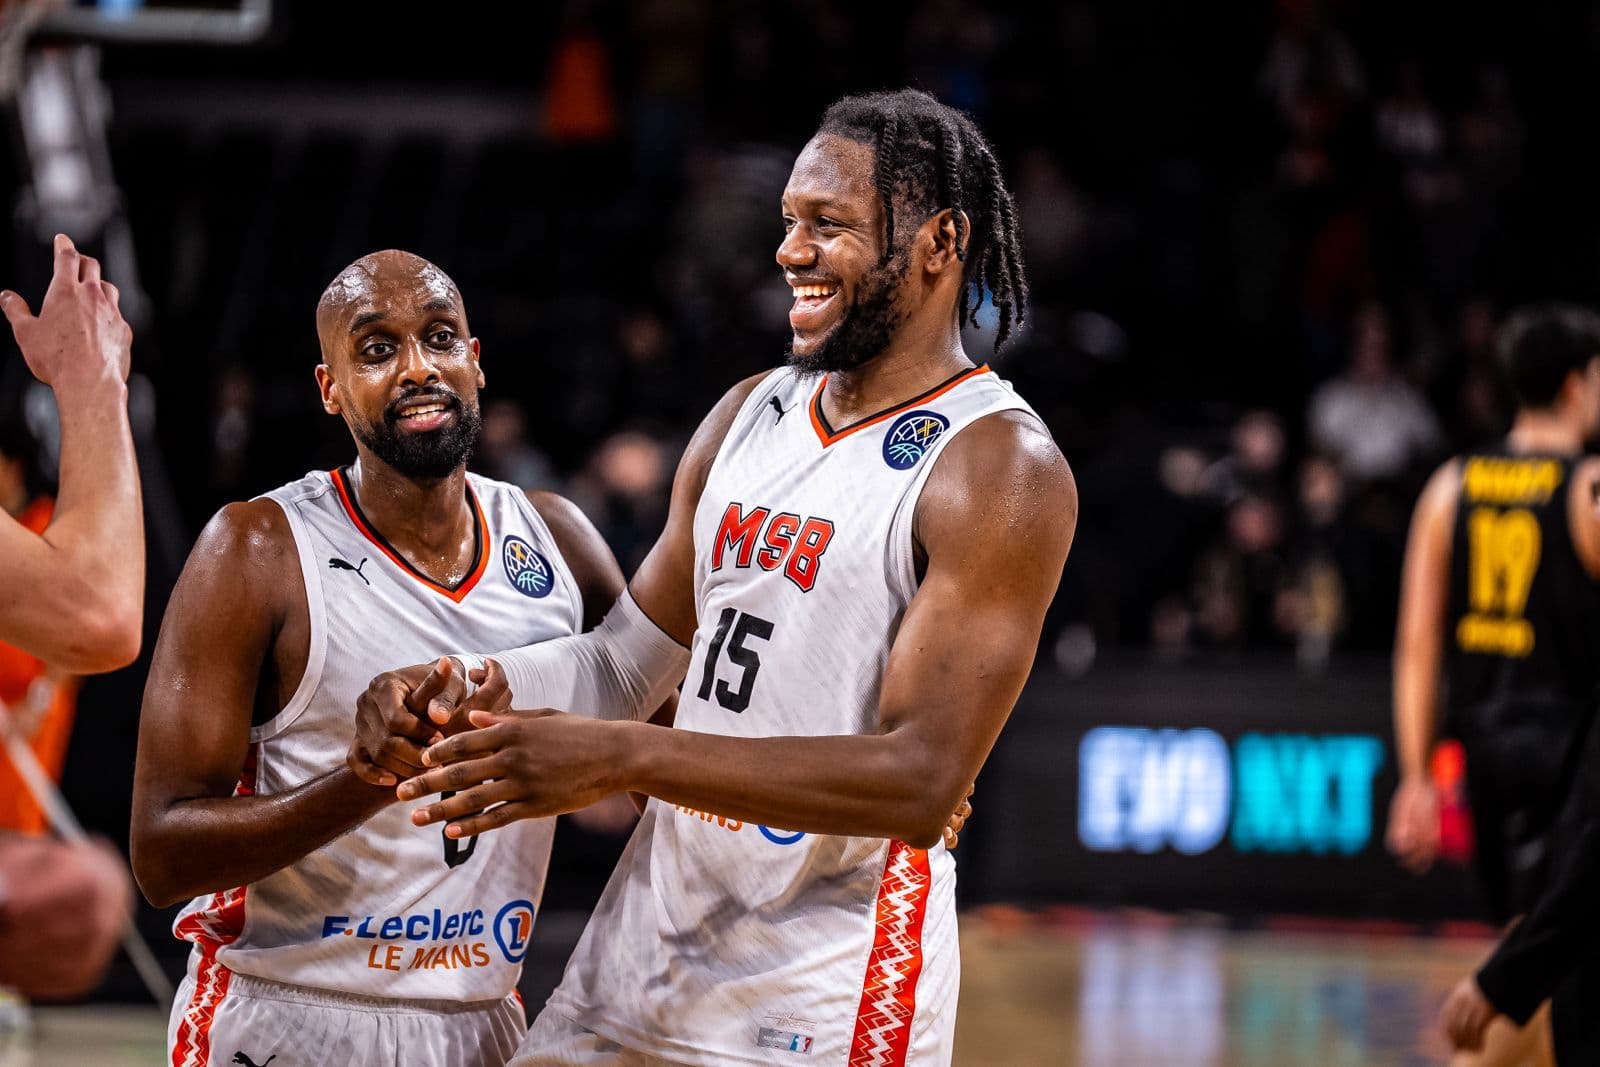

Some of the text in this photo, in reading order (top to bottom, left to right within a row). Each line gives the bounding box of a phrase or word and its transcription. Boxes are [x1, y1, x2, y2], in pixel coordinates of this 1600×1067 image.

[712, 502, 835, 593] MSB
[697, 607, 775, 713] 15
[367, 943, 490, 971] LE MANS
